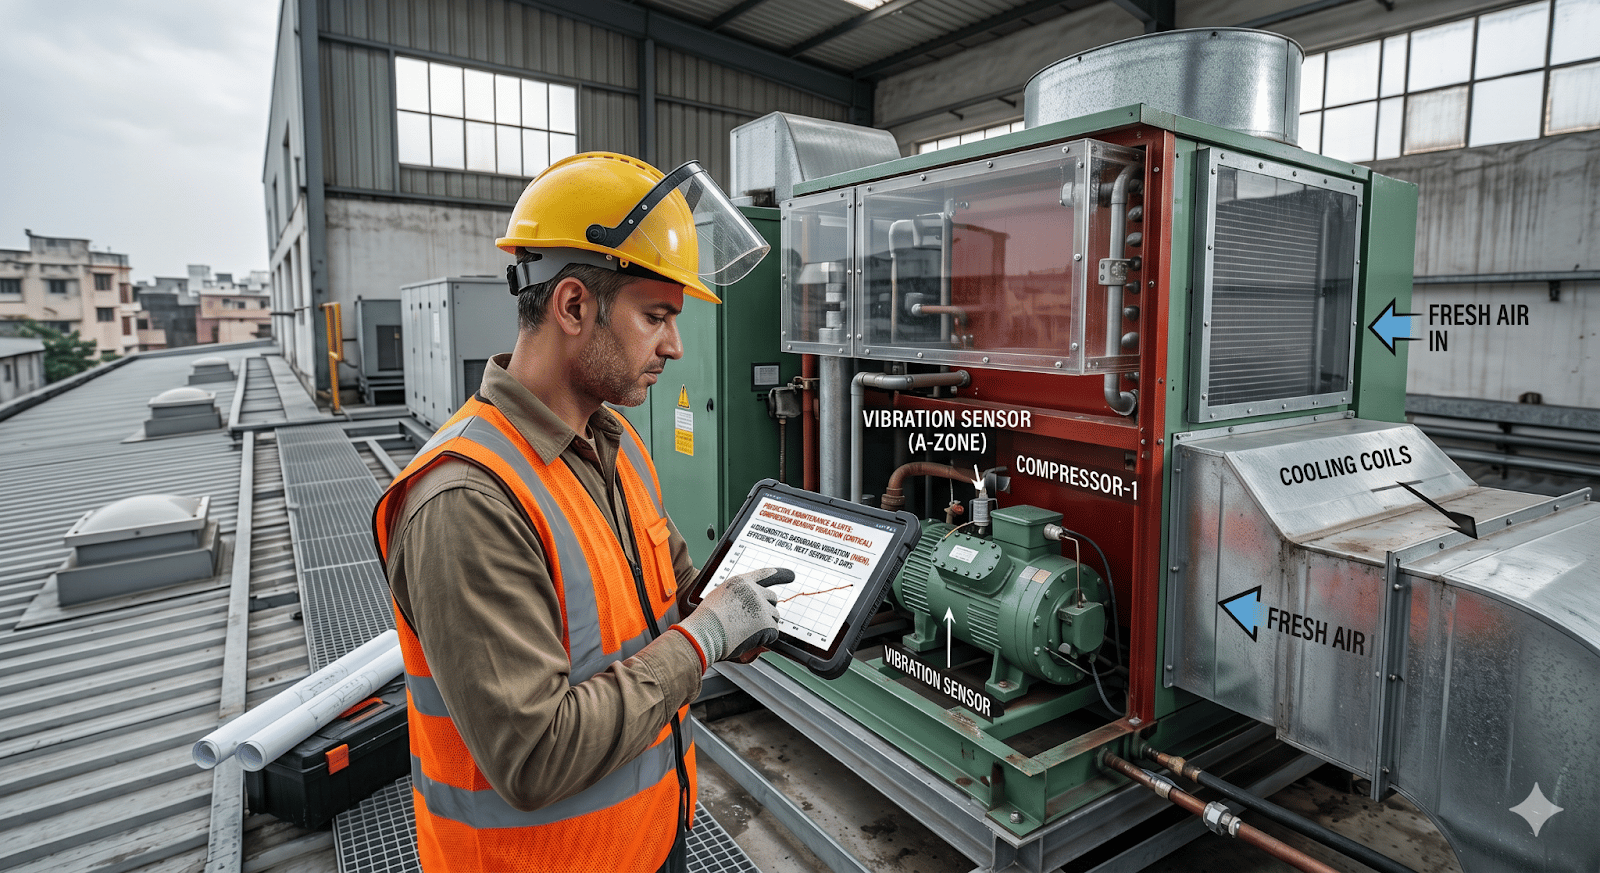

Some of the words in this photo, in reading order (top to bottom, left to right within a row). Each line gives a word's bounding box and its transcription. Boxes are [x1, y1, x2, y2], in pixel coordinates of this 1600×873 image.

[793, 544, 809, 555] NEXT
[833, 557, 840, 565] 3
[838, 559, 854, 569] DAYS
